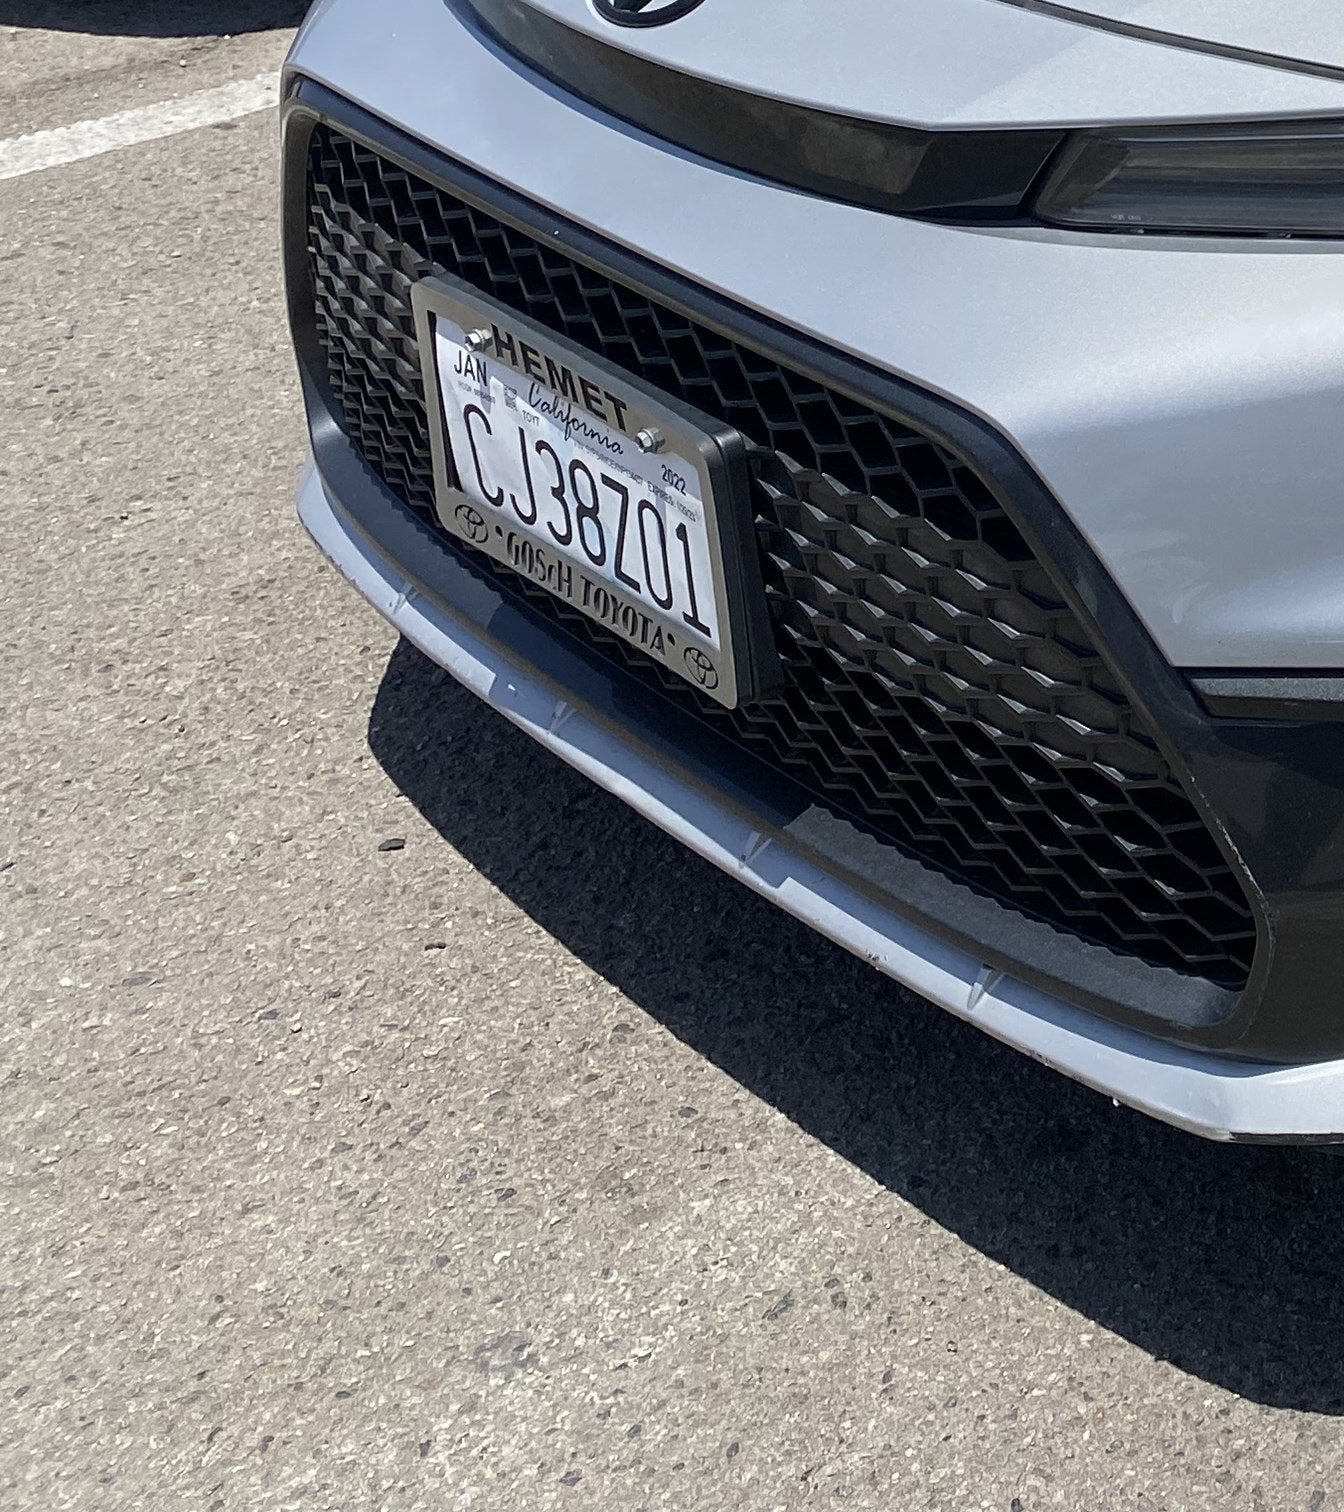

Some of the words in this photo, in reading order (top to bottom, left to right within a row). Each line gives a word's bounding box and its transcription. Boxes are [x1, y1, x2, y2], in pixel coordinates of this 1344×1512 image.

[454, 350, 488, 386] JAN
[491, 324, 629, 432] HEMET
[528, 382, 624, 455] California
[661, 464, 686, 496] 2022
[463, 402, 712, 639] CJ38Z01
[580, 575, 666, 656] TOYOTA
